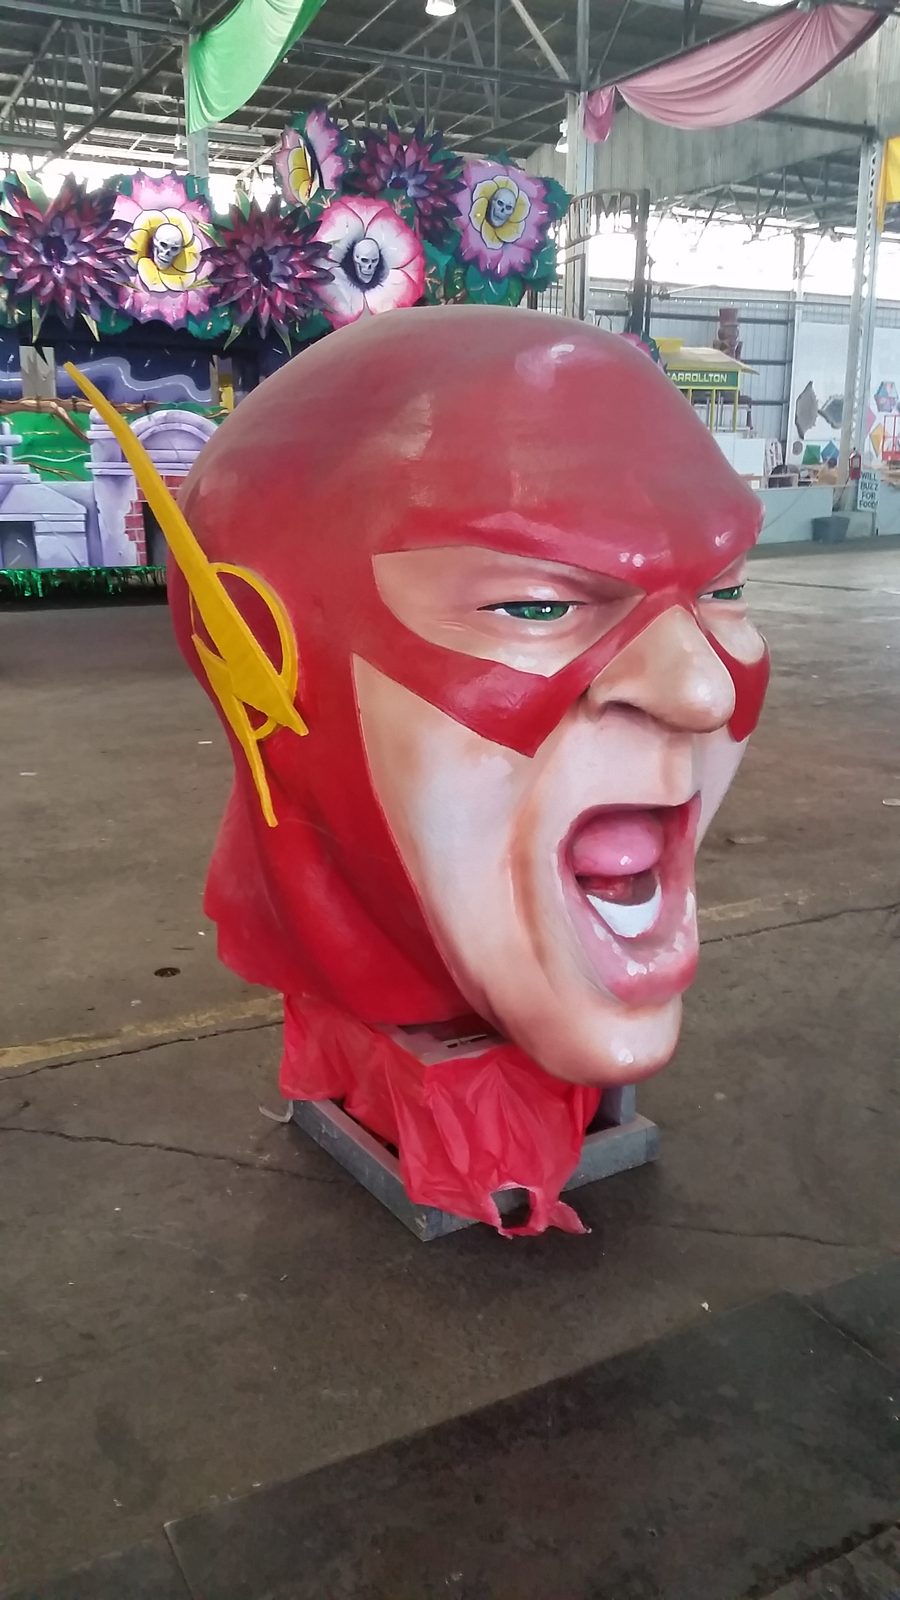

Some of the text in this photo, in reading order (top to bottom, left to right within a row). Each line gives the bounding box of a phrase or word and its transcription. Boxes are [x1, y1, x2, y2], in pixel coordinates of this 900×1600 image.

[667, 372, 728, 383] ARROLLTON
[862, 472, 877, 481] WILL
[861, 491, 876, 500] FOR
